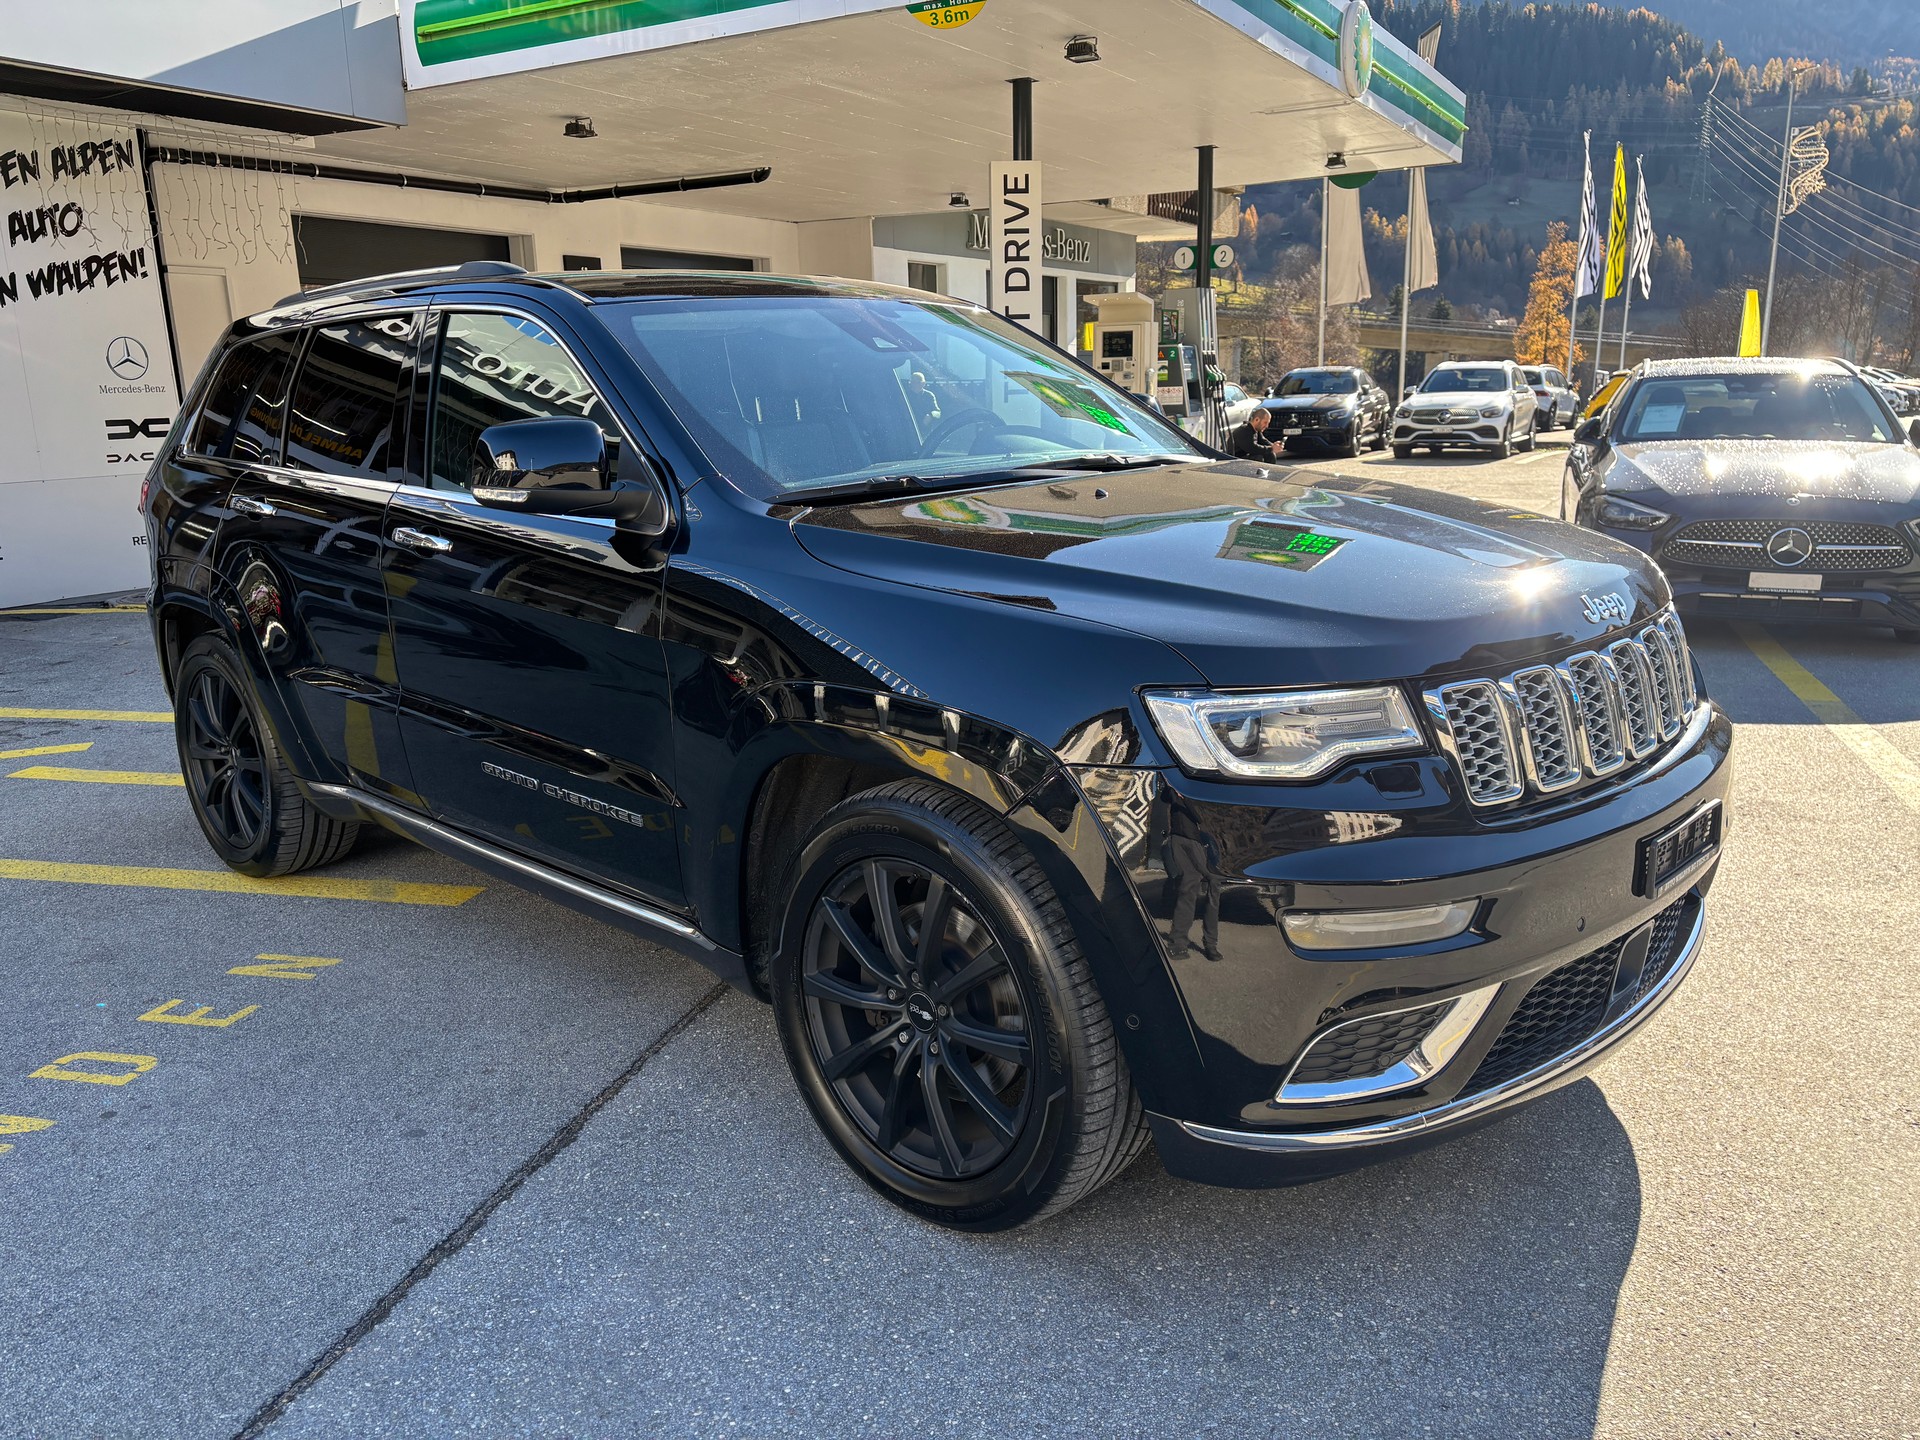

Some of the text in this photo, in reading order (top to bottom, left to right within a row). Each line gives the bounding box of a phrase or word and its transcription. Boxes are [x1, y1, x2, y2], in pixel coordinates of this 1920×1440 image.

[923, 2, 945, 11] max.
[929, 9, 970, 26] 3.6m
[51, 138, 135, 182] ALPEN
[8, 201, 84, 247] AUTO
[1003, 173, 1030, 293] DRIVE
[25, 247, 149, 301] WALPEN!
[1220, 250, 1227, 263] 2
[99, 384, 166, 394] Mercedes-Benz
[1580, 591, 1629, 624] Jeep
[481, 761, 539, 791] GRAND
[542, 782, 644, 828] CHEROKEE
